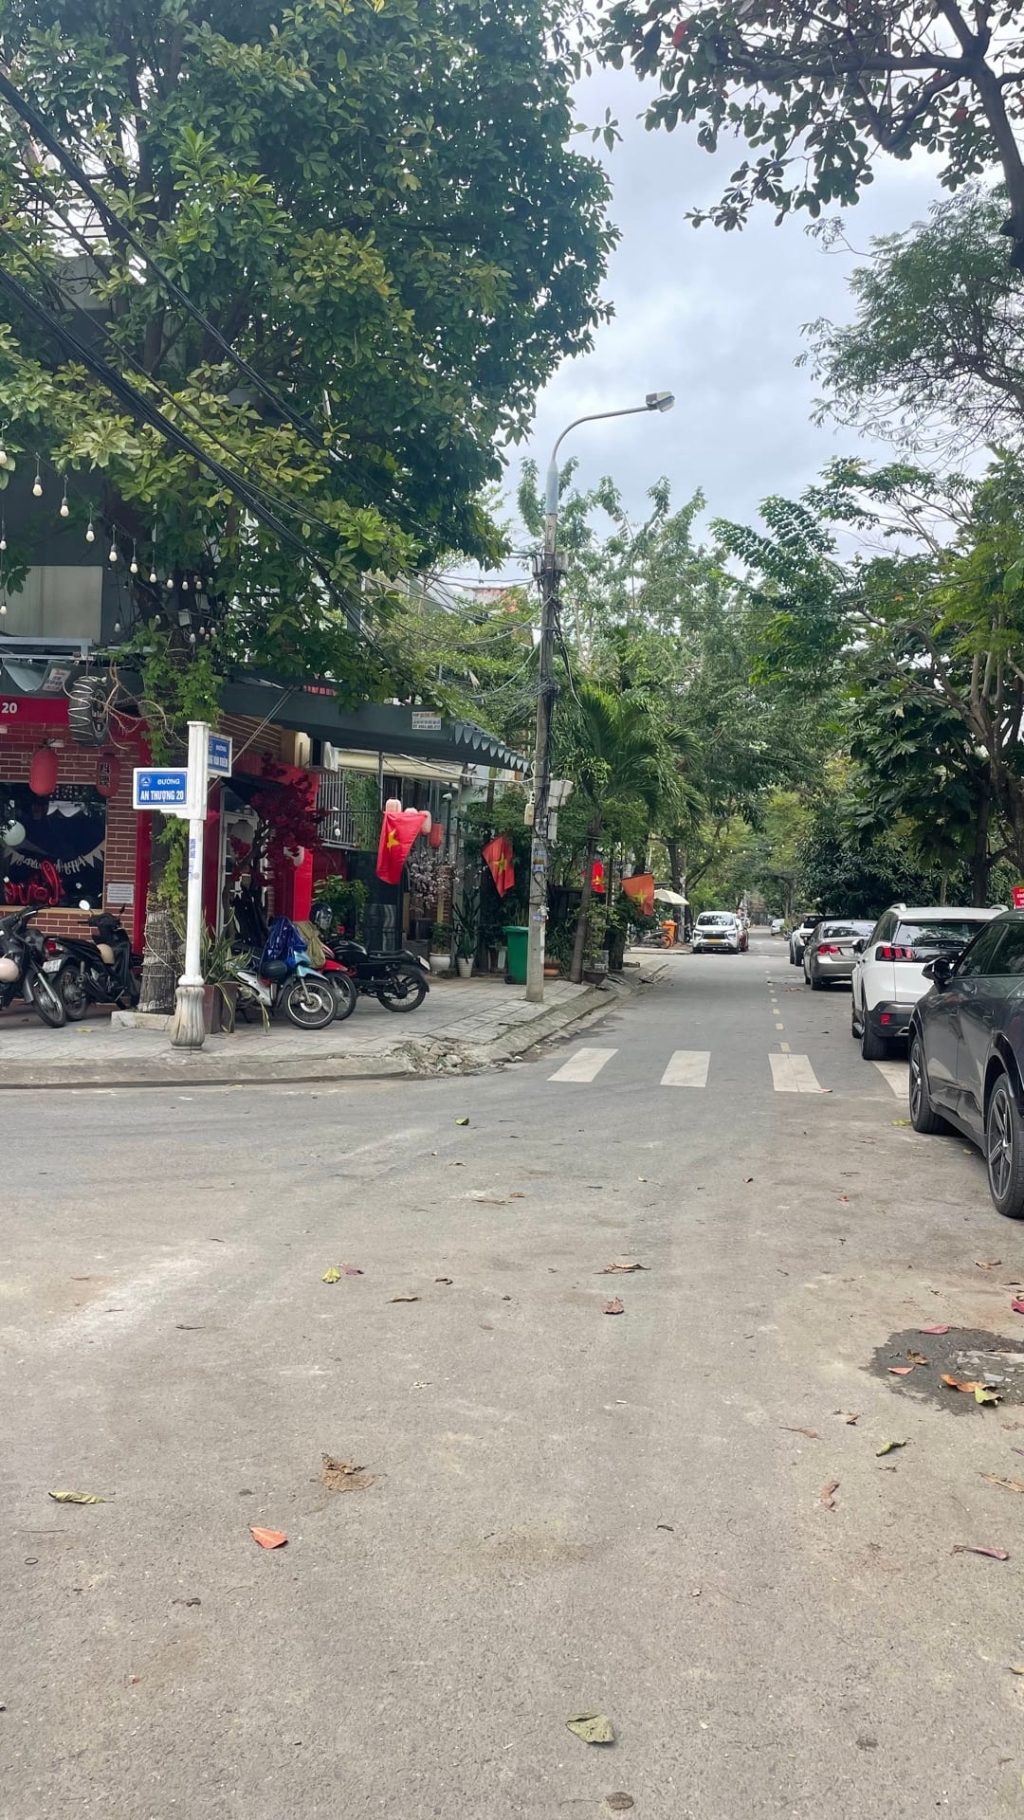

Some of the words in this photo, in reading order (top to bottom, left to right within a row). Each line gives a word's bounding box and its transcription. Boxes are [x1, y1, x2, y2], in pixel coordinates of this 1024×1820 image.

[1, 702, 18, 714] 20
[157, 777, 181, 786] ĐƯỜNG
[140, 790, 150, 801] AN
[150, 790, 175, 802] THƯỢNG
[176, 790, 184, 801] 20
